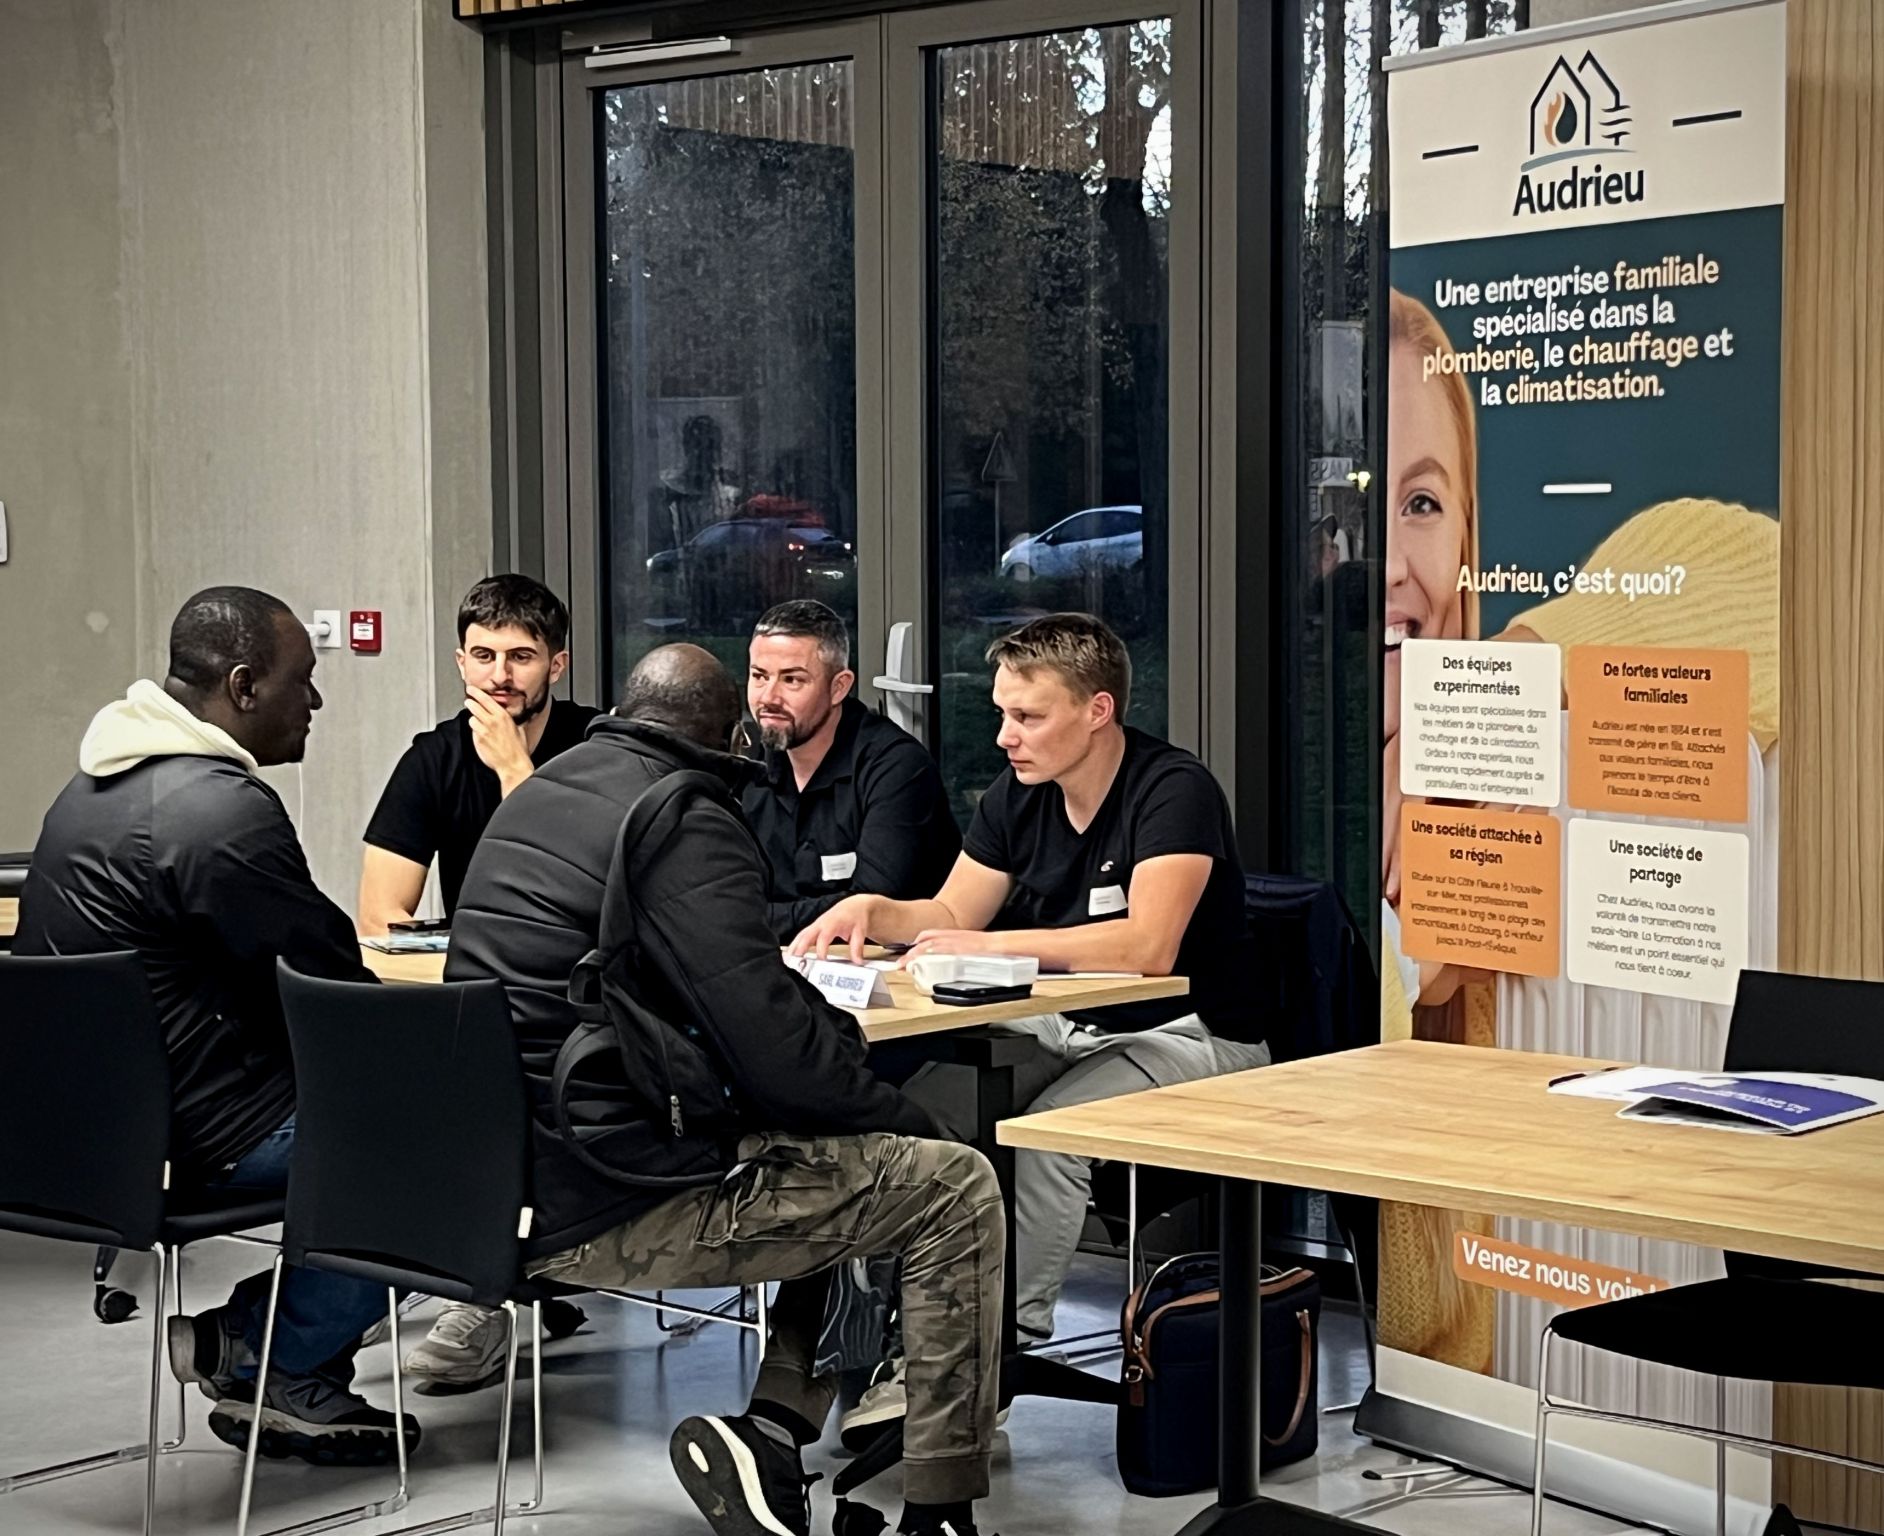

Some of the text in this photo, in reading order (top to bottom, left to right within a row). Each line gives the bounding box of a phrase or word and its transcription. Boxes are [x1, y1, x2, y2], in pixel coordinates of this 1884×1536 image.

[1513, 164, 1644, 216] Audrieu
[1435, 253, 1719, 308] Une entreprise familiale
[1472, 294, 1675, 345] spécialisé dans la
[1423, 327, 1734, 383] plomberie, le chauffage et
[1481, 368, 1665, 406] la climatisation.
[1456, 564, 1686, 601] Audrieu, c’est quoi?
[1442, 656, 1512, 675] Des équipes
[1603, 662, 1711, 680] De fortes valeurs
[1433, 680, 1520, 696] experimentées
[1623, 687, 1688, 704] familiales
[1411, 820, 1543, 845] Une société attachée à
[1449, 847, 1503, 866] sa région
[1609, 840, 1703, 861] Une société de
[1629, 868, 1682, 887] partage
[1461, 1237, 1531, 1279] Venez
[1535, 1263, 1591, 1295] nous
